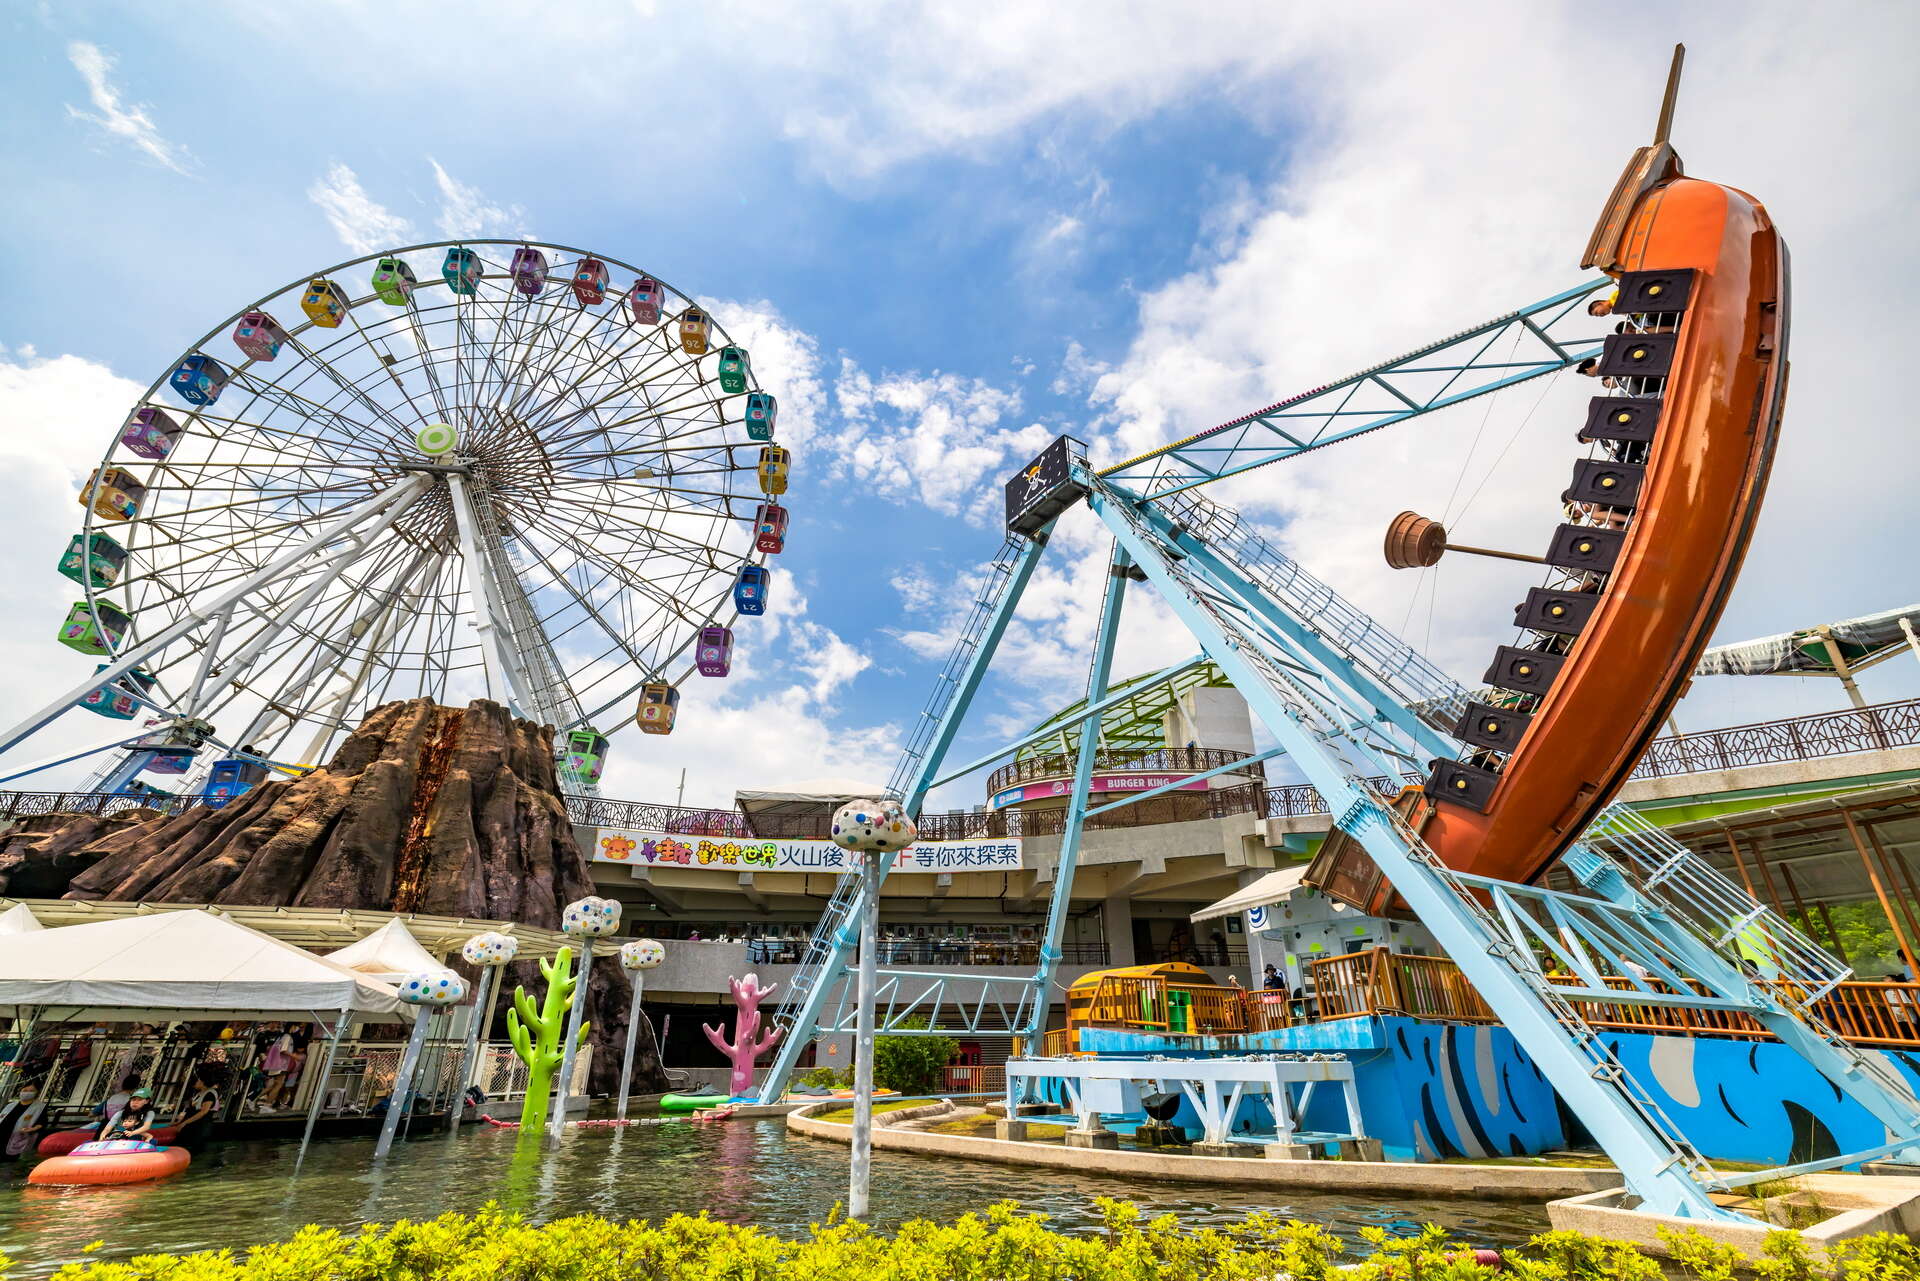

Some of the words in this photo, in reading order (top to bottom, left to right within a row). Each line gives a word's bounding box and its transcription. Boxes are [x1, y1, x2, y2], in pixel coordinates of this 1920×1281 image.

[686, 340, 701, 349] 26
[725, 379, 739, 388] 25
[185, 390, 202, 399] 07
[752, 427, 767, 435] 24
[760, 541, 776, 549] 22
[1107, 779, 1145, 788] BURGER
[1148, 778, 1169, 787] KING
